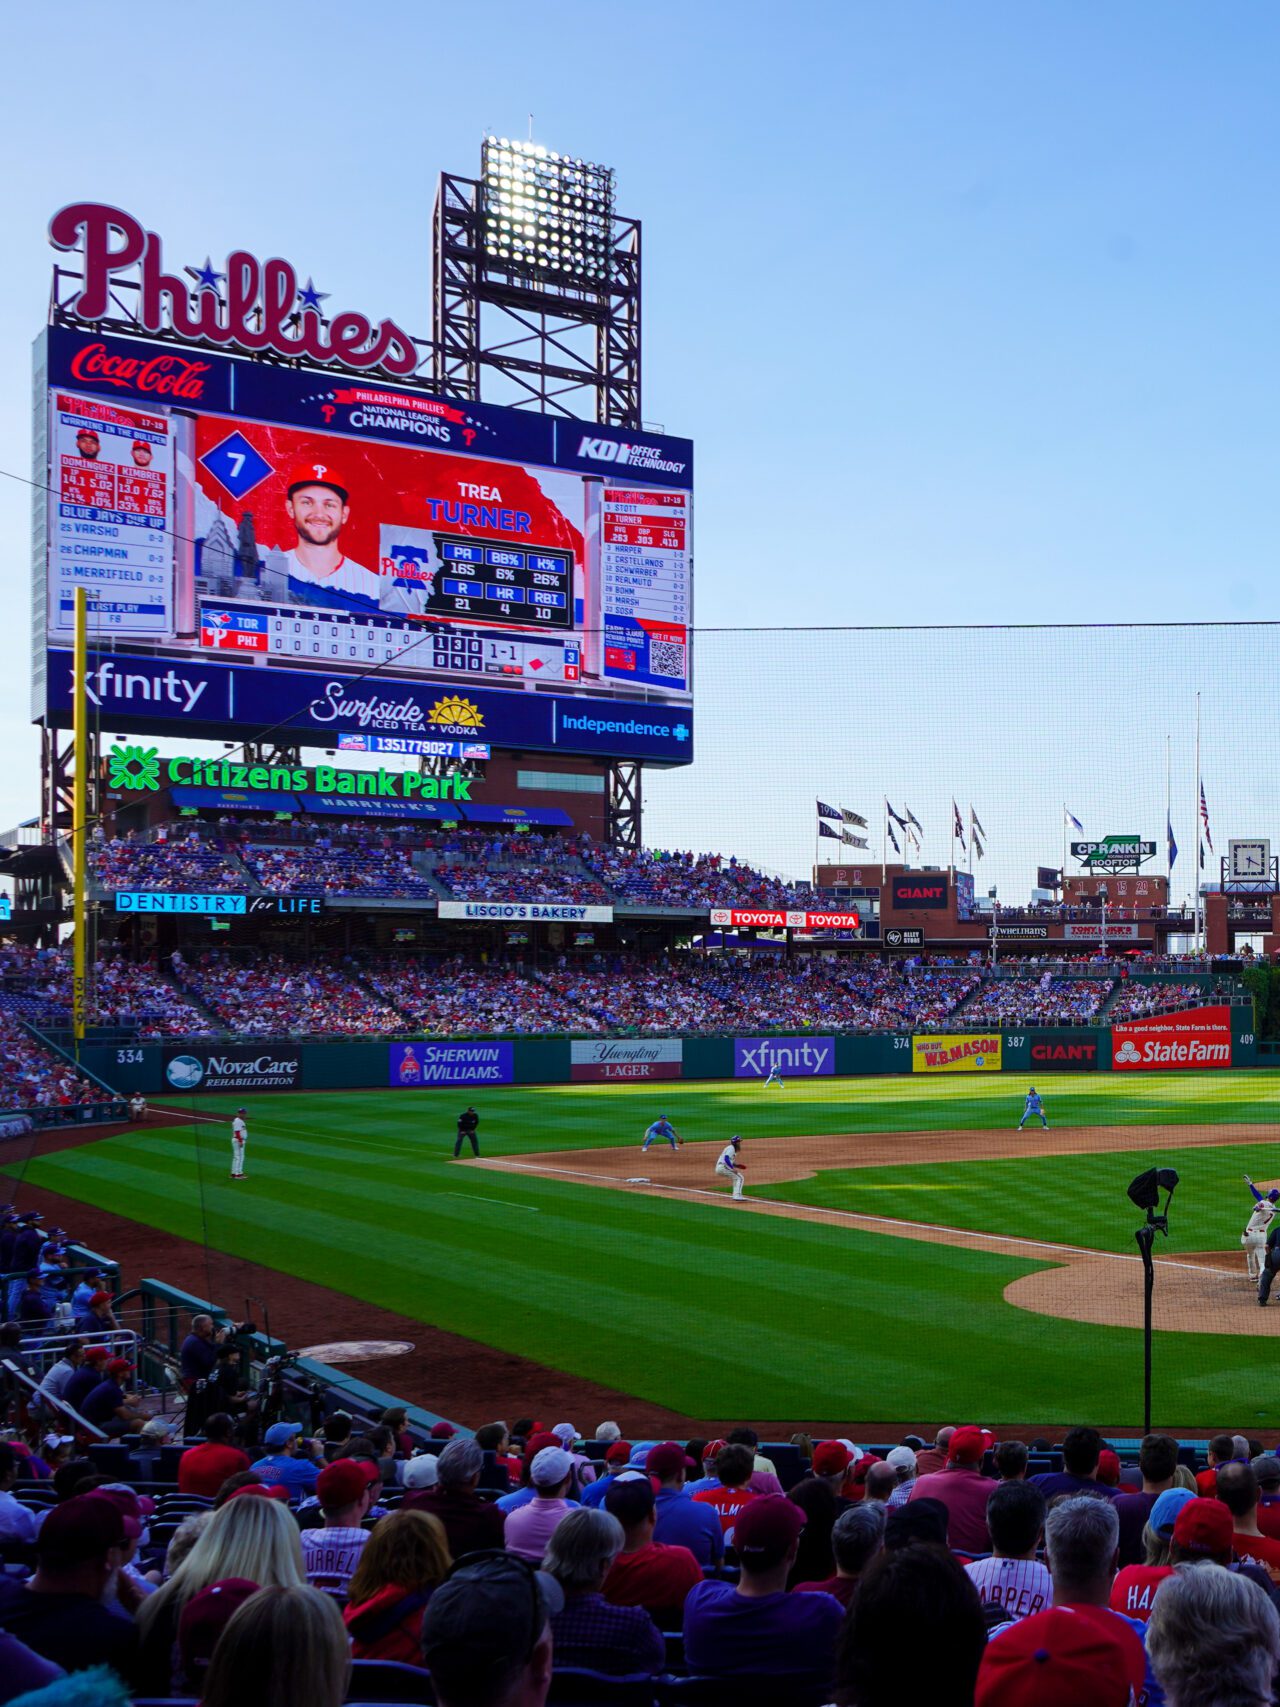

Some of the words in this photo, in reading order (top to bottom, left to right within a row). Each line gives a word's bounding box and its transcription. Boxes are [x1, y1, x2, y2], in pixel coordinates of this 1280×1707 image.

[48, 201, 419, 377] Phillies
[70, 343, 212, 399] Coca-Cola
[356, 391, 411, 407] PHILADELPHIA
[412, 400, 446, 415] PHILLIES
[362, 405, 407, 418] NATIONAL
[408, 411, 441, 425] LEAGUE
[62, 415, 104, 431] WARMING
[105, 421, 116, 434] IN
[117, 424, 132, 438] THE
[133, 428, 167, 446] BULLPEN
[350, 411, 451, 443] CHAMPIONS
[630, 444, 662, 460] OFFICE
[226, 451, 247, 478] 7
[627, 454, 686, 474] TECHNOLOGY
[122, 466, 161, 482] KIMBREL
[457, 481, 503, 503] TREA
[61, 505, 92, 519] BLUE
[95, 510, 124, 524] JAYS
[149, 518, 164, 528] UP
[426, 498, 532, 534] TURNER
[74, 523, 119, 538] VARSHO
[74, 545, 128, 559] CHAPMAN
[453, 544, 472, 560] PA
[491, 549, 519, 567] BB%
[615, 546, 643, 555] HARPER
[381, 545, 434, 582] Phillies
[451, 562, 476, 576] 165
[537, 558, 556, 571] K%
[615, 556, 664, 568] CASTELLANOS
[74, 566, 143, 581] MERRIFIELD
[495, 568, 515, 582] 6%
[615, 565, 658, 577] SCHWARBER
[533, 573, 560, 588] 26%
[458, 583, 468, 594] R
[496, 587, 515, 600] HR
[454, 598, 471, 611] 21
[534, 592, 558, 605] RBI
[91, 601, 114, 612] LAST
[116, 603, 139, 613] PLAY
[500, 603, 510, 615] 4
[536, 607, 551, 620] 10
[236, 616, 259, 630] TOR
[236, 635, 259, 648] PHI
[490, 643, 517, 661] 1-1
[68, 662, 208, 712] xfinity
[309, 682, 425, 727] Surfside
[371, 719, 399, 730] ICED
[404, 721, 426, 732] TEA
[440, 724, 479, 736] VODKA
[562, 714, 670, 738] Independence
[376, 737, 454, 756] 1351779027
[168, 756, 308, 792] Citizens
[314, 764, 398, 796] Bank
[403, 771, 473, 801] Park
[321, 799, 382, 809] HARRY
[407, 803, 438, 812] K'S
[1077, 843, 1097, 854] CP
[1098, 842, 1150, 854] RANKIN
[897, 886, 944, 899] GIANT
[118, 894, 244, 911] DENTISTRY
[249, 897, 274, 913] for
[278, 899, 321, 914] LIFE
[465, 905, 527, 918] LISCIO'S
[531, 907, 588, 919] BAKERY
[734, 912, 784, 925] TOYOTA
[809, 914, 856, 926] TOYOTA
[1134, 1025, 1148, 1033] good
[893, 1038, 910, 1049] 374
[1007, 1036, 1025, 1048] 387
[1240, 1034, 1254, 1045] 409
[116, 1050, 144, 1064] 334
[424, 1047, 500, 1062] SHERWIN
[592, 1043, 662, 1063] Yuengling
[741, 1040, 829, 1074] xfinity
[1031, 1045, 1096, 1060] GIANT
[205, 1056, 297, 1075] NovaCare
[423, 1065, 501, 1081] WILLIAMS
[605, 1065, 650, 1077] LAGER
[205, 1077, 295, 1087] REHABILITATION
